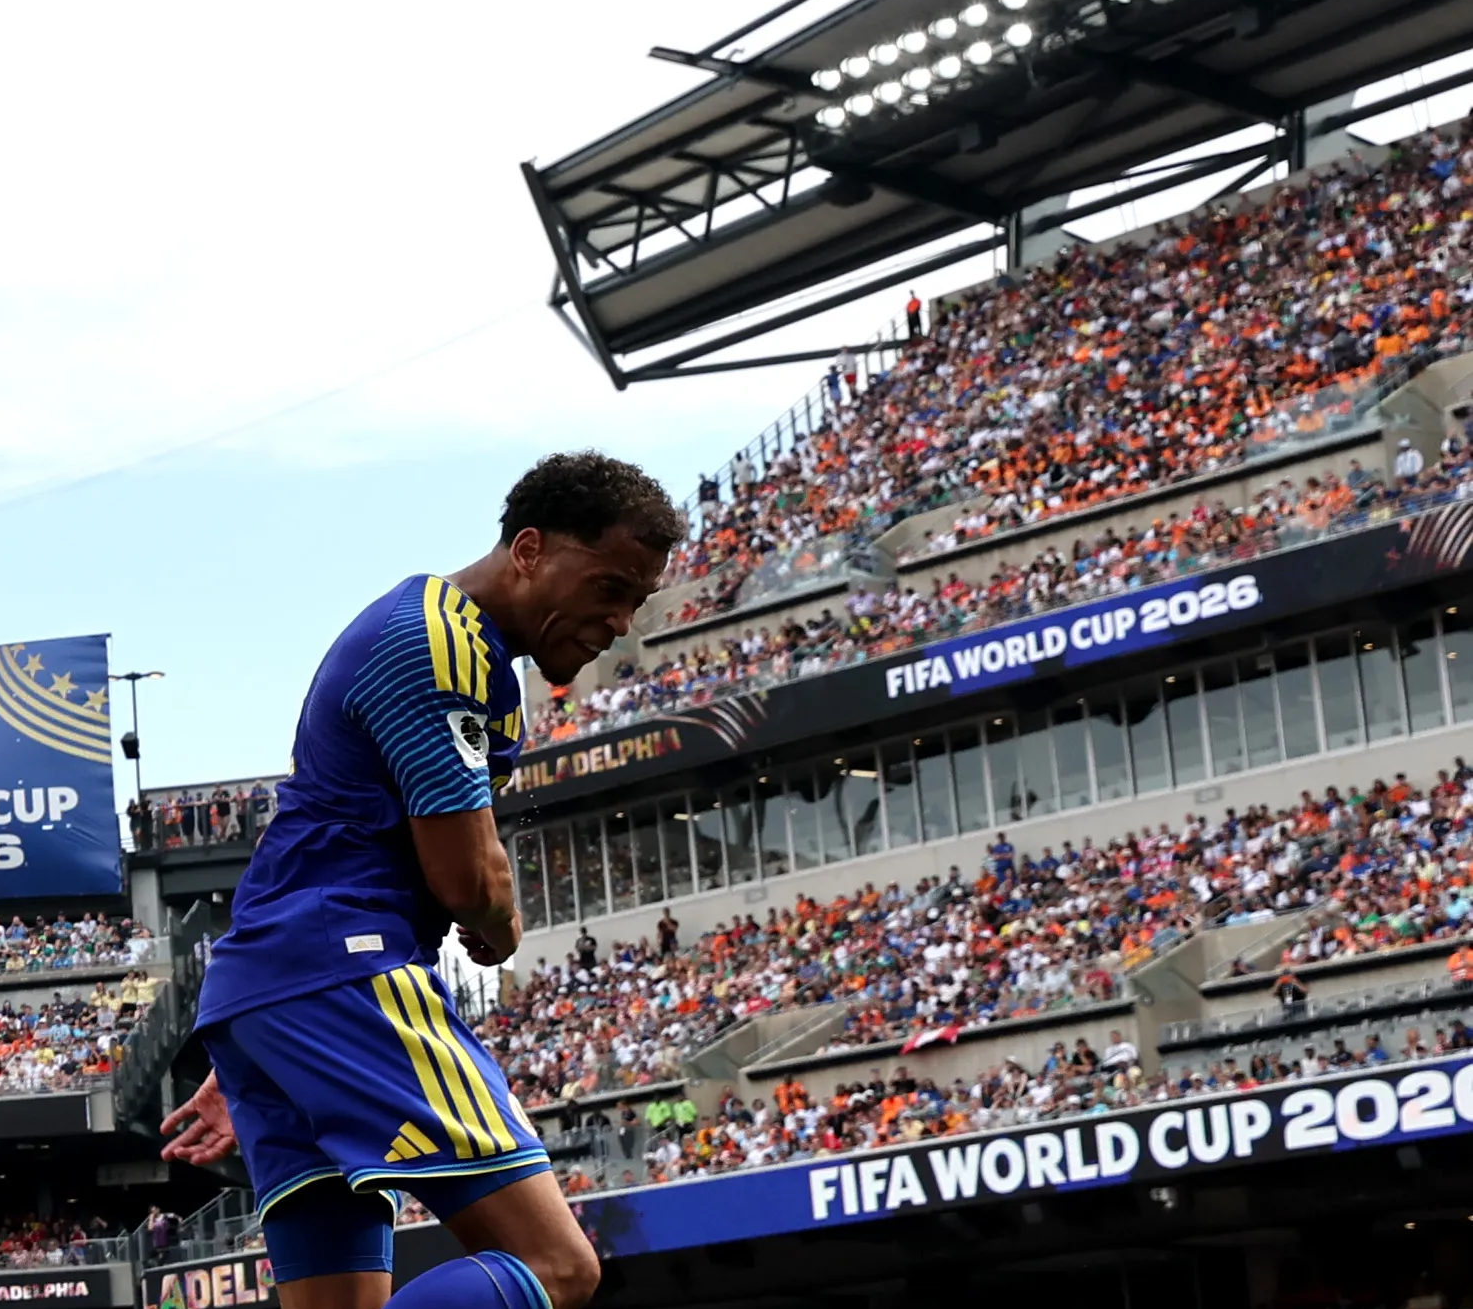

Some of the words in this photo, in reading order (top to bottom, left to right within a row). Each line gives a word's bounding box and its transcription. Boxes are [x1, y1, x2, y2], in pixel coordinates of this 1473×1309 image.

[886, 656, 953, 697] FIFA
[953, 626, 1067, 679] WORLD
[1070, 606, 1137, 650] CUP
[1140, 575, 1260, 632] 2026
[500, 726, 684, 796] HILADELPHIA
[809, 1155, 927, 1220] FIFA
[928, 1122, 1140, 1201] WORLD
[1148, 1099, 1272, 1168] CUP
